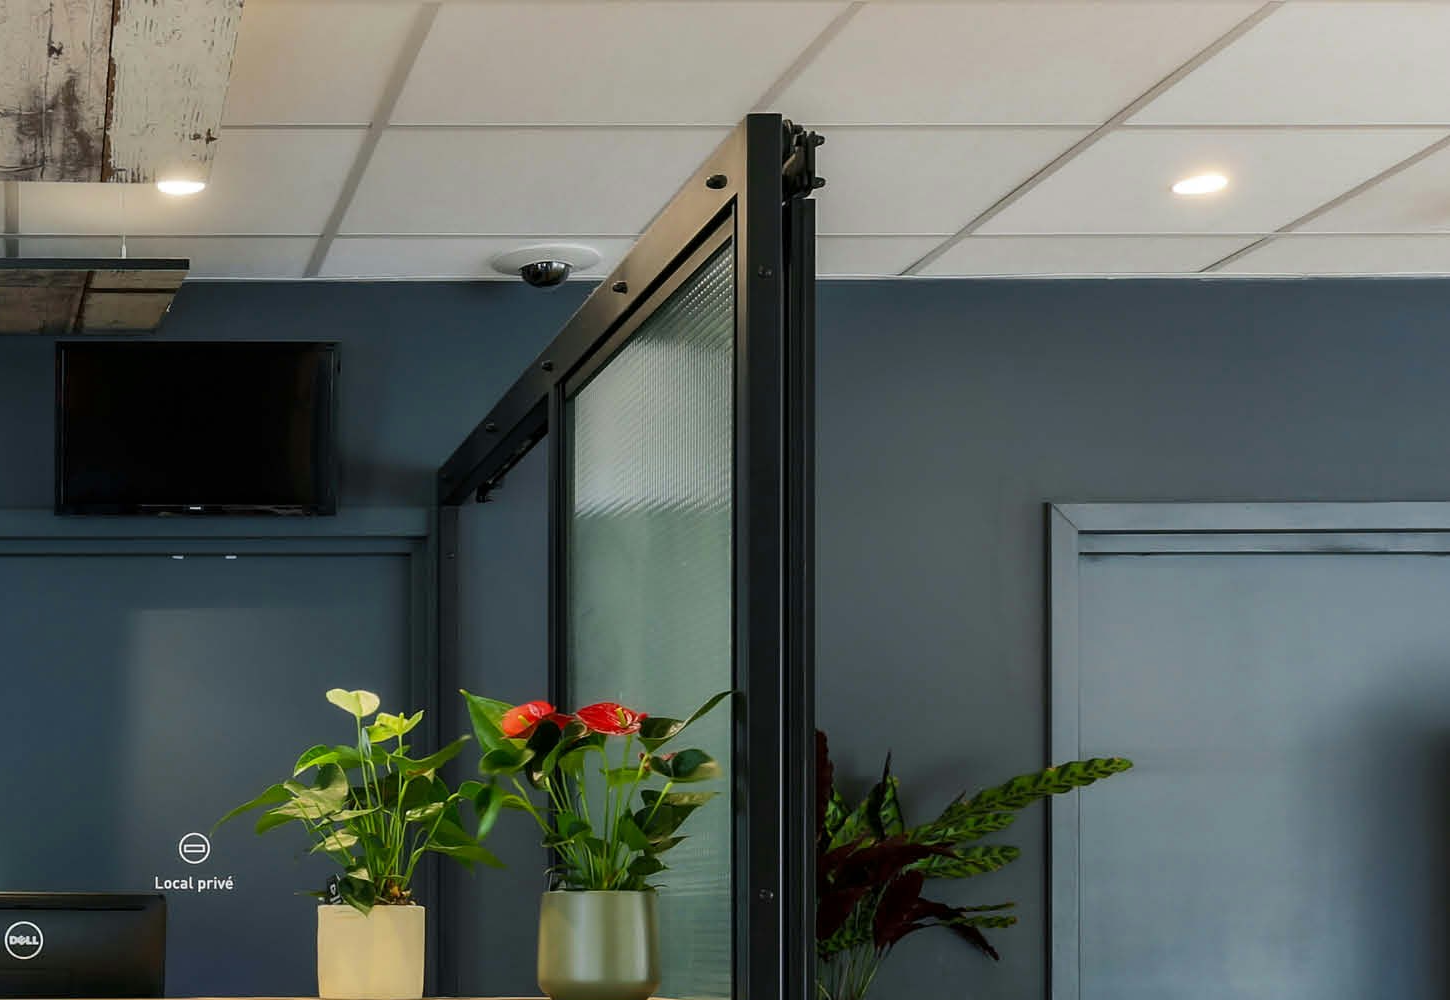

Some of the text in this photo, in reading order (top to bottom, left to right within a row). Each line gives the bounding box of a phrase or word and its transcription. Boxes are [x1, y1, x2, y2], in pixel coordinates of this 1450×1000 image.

[155, 876, 234, 893] Local privé
[9, 935, 39, 946] DELL
